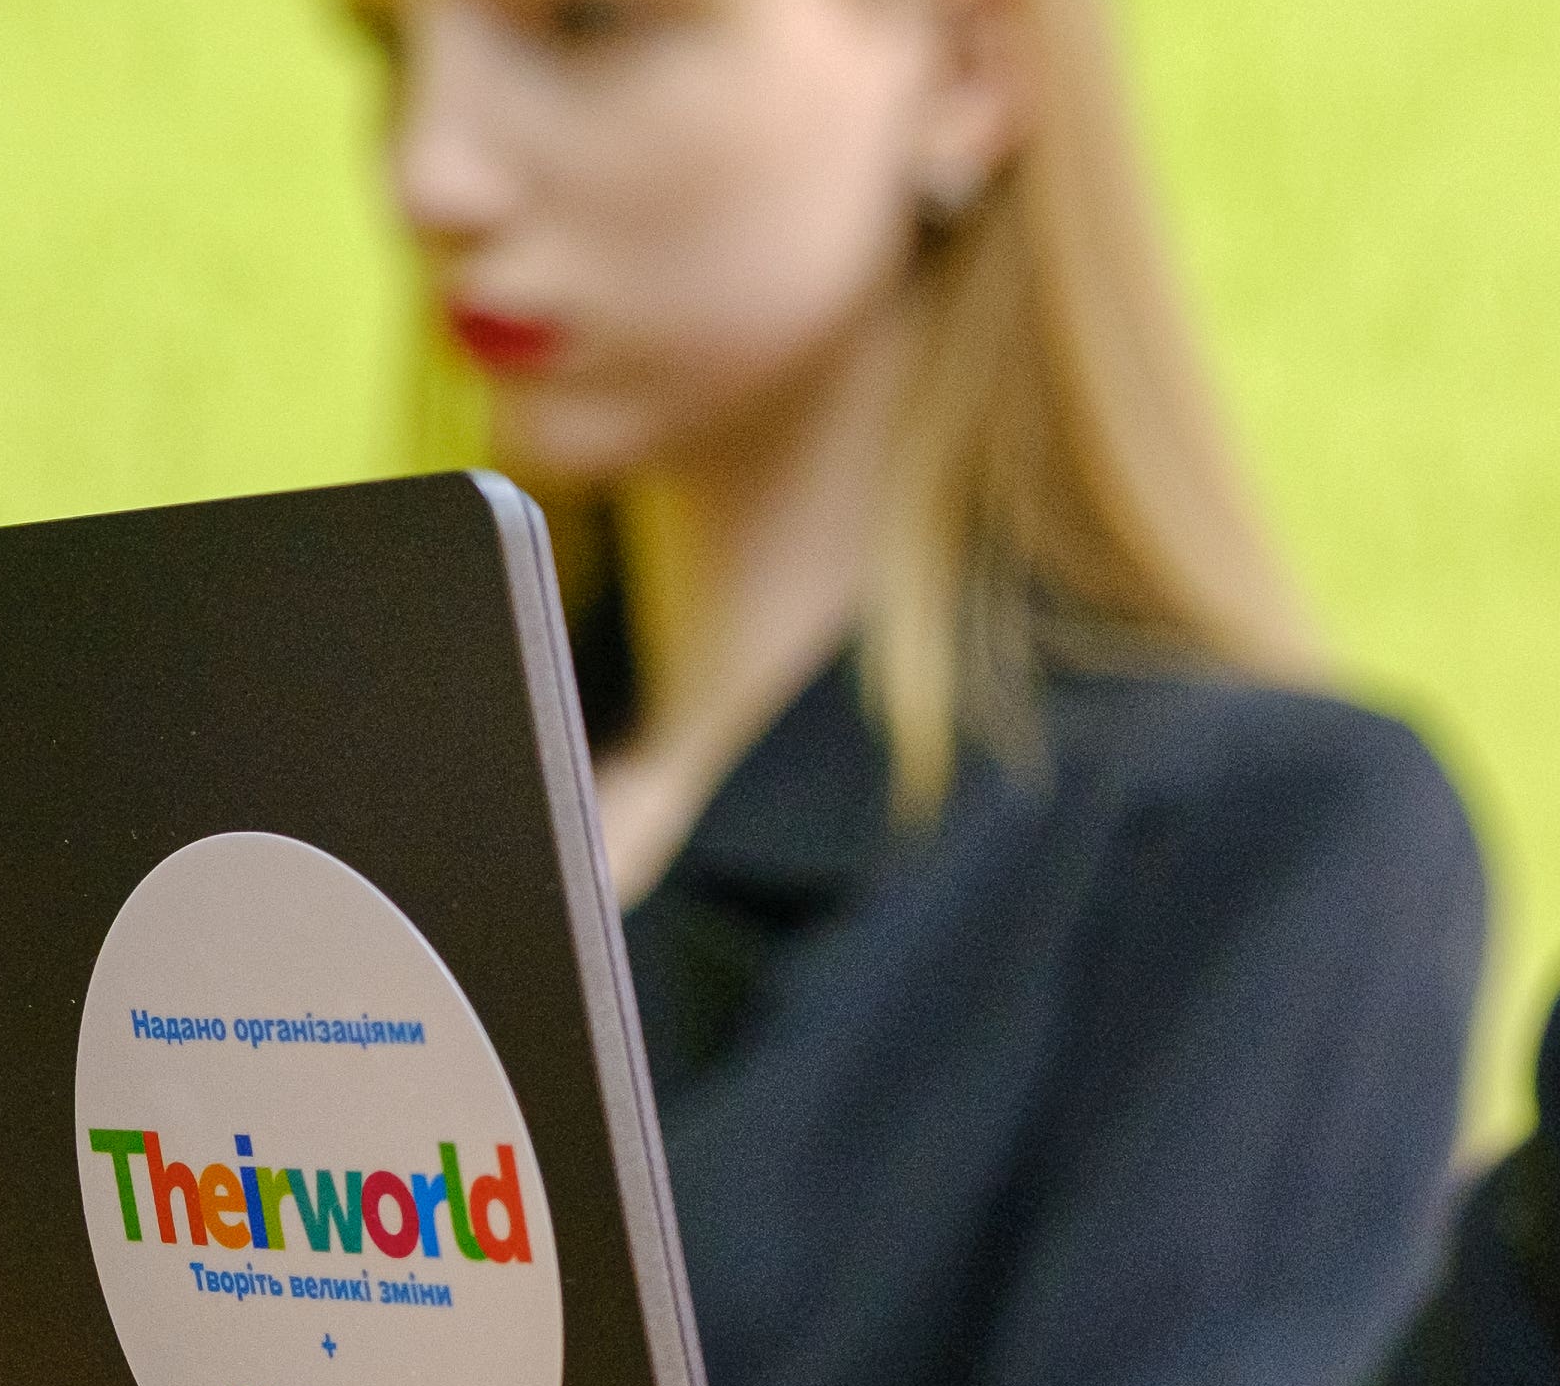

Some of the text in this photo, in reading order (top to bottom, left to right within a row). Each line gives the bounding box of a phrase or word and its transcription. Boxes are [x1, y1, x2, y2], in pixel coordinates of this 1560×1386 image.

[131, 1010, 425, 1050] Надано організаціями
[89, 1128, 533, 1265] Theirworld
[190, 1263, 453, 1308] Творіть великі зміни
